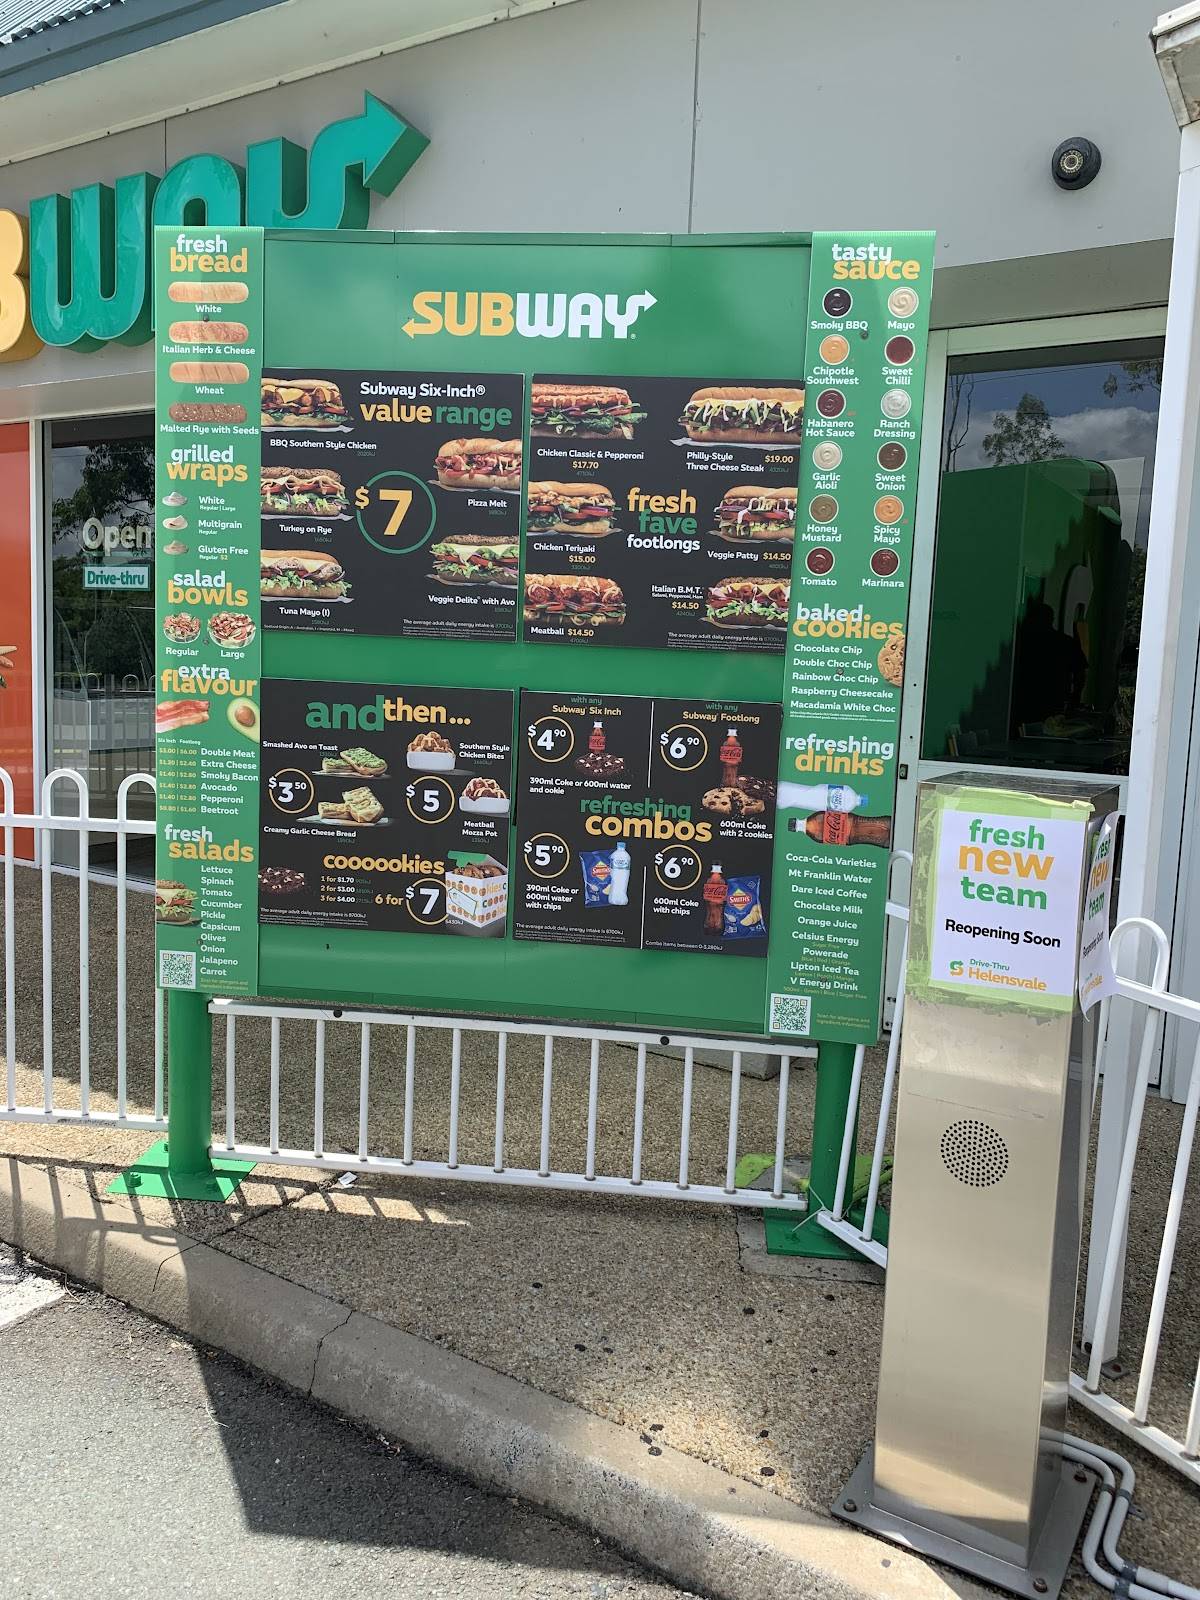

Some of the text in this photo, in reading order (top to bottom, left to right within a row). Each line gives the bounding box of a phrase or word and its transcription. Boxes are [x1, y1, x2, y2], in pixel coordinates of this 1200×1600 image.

[176, 234, 227, 253] fresh
[832, 243, 892, 264] tasty
[170, 247, 247, 272] bread
[833, 260, 920, 280] sauce
[195, 304, 222, 313] White
[402, 290, 657, 339] SUBWAY
[811, 321, 868, 331] Smoky BBQ
[888, 321, 915, 330] Mayo
[162, 345, 190, 353] Italian
[191, 346, 213, 354] Herb
[813, 367, 854, 377] Chipotle
[882, 367, 912, 375] Sweet
[807, 376, 859, 384] Southwest
[195, 386, 224, 395] Wheat
[360, 382, 416, 399] Subway
[360, 398, 512, 431] value range
[808, 419, 854, 428] Habanero
[160, 424, 259, 435] Malted Rye with Seeds
[806, 429, 855, 437] Hot Sauce
[270, 439, 376, 450] BBQ Southern Style Chicken
[171, 444, 234, 465] grilled
[537, 449, 567, 457] Chicken
[569, 450, 595, 458] Classic
[605, 451, 644, 461] Pepperoni
[687, 452, 733, 462] Philly-Style
[765, 455, 793, 463] $19.00
[573, 461, 598, 469] $17.70
[687, 463, 708, 471] Three
[741, 464, 764, 472] Steak
[166, 463, 248, 487] wraps
[813, 473, 840, 481] Garlic
[815, 481, 837, 489] Aioli
[199, 496, 224, 505] White
[468, 499, 507, 508] Pizza Melt
[628, 487, 696, 514] fresh
[198, 520, 242, 529] Multigrain
[639, 510, 696, 534] fave
[279, 525, 304, 534] Turkey
[807, 524, 837, 534] Honey
[82, 517, 150, 557] Open
[802, 534, 841, 542] Mustard
[534, 543, 595, 553] Chicken Teriyaki
[627, 535, 700, 553] footlongs
[198, 546, 248, 555] Gluten Free
[708, 551, 758, 561] Veggie Patty
[763, 552, 791, 560] $14.50
[569, 555, 595, 563] $15.00
[87, 571, 144, 586] Drive-thru
[173, 570, 226, 587] salad
[801, 577, 837, 585] Tomato
[862, 579, 904, 588] Marinara
[168, 580, 248, 607] bowls
[797, 603, 863, 622] baked
[531, 627, 564, 636] Meatball
[793, 614, 904, 639] cookies
[165, 647, 245, 659] Regular Large
[794, 644, 839, 653] Chocolate
[842, 646, 862, 655] Chip
[179, 664, 230, 680] extra
[161, 669, 257, 696] flavour
[792, 687, 893, 698] Raspberry Cheesecake
[459, 743, 510, 752] Southern Style
[786, 734, 894, 760] refreshing
[201, 748, 255, 758] Double Meat
[201, 760, 256, 769] Extra Cheese
[795, 748, 884, 776] drinks
[530, 778, 553, 786] 390ml
[584, 780, 608, 789] 600ml
[201, 795, 243, 804] Pepperoni
[201, 806, 238, 815] Beetroot
[579, 796, 691, 821] refreshing
[464, 821, 494, 829] Meatball
[585, 811, 712, 842] combos
[720, 821, 766, 830] 600ml Coke
[164, 824, 212, 842] fresh
[462, 829, 483, 837] Mozza
[970, 819, 1045, 850] fresh
[169, 837, 254, 862] salads
[786, 853, 877, 868] Coca-Cola Varieties
[959, 845, 1054, 880] new
[201, 866, 232, 874] Lettuce
[1091, 860, 1108, 890] new
[201, 877, 234, 886] Spinach
[201, 888, 232, 897] Tomato
[961, 876, 1047, 910] team
[201, 900, 242, 909] Cucumber
[375, 894, 404, 905] 6 for
[201, 922, 240, 932] Capsicum
[798, 916, 857, 929] Orange Juice
[945, 919, 1020, 944] Reopening
[1023, 930, 1061, 948] Soon
[803, 948, 848, 959] Powerade
[791, 962, 859, 975] Lipton Iced Tea
[970, 959, 1010, 971] Drive-Thru
[969, 967, 1046, 991] Helensvale
